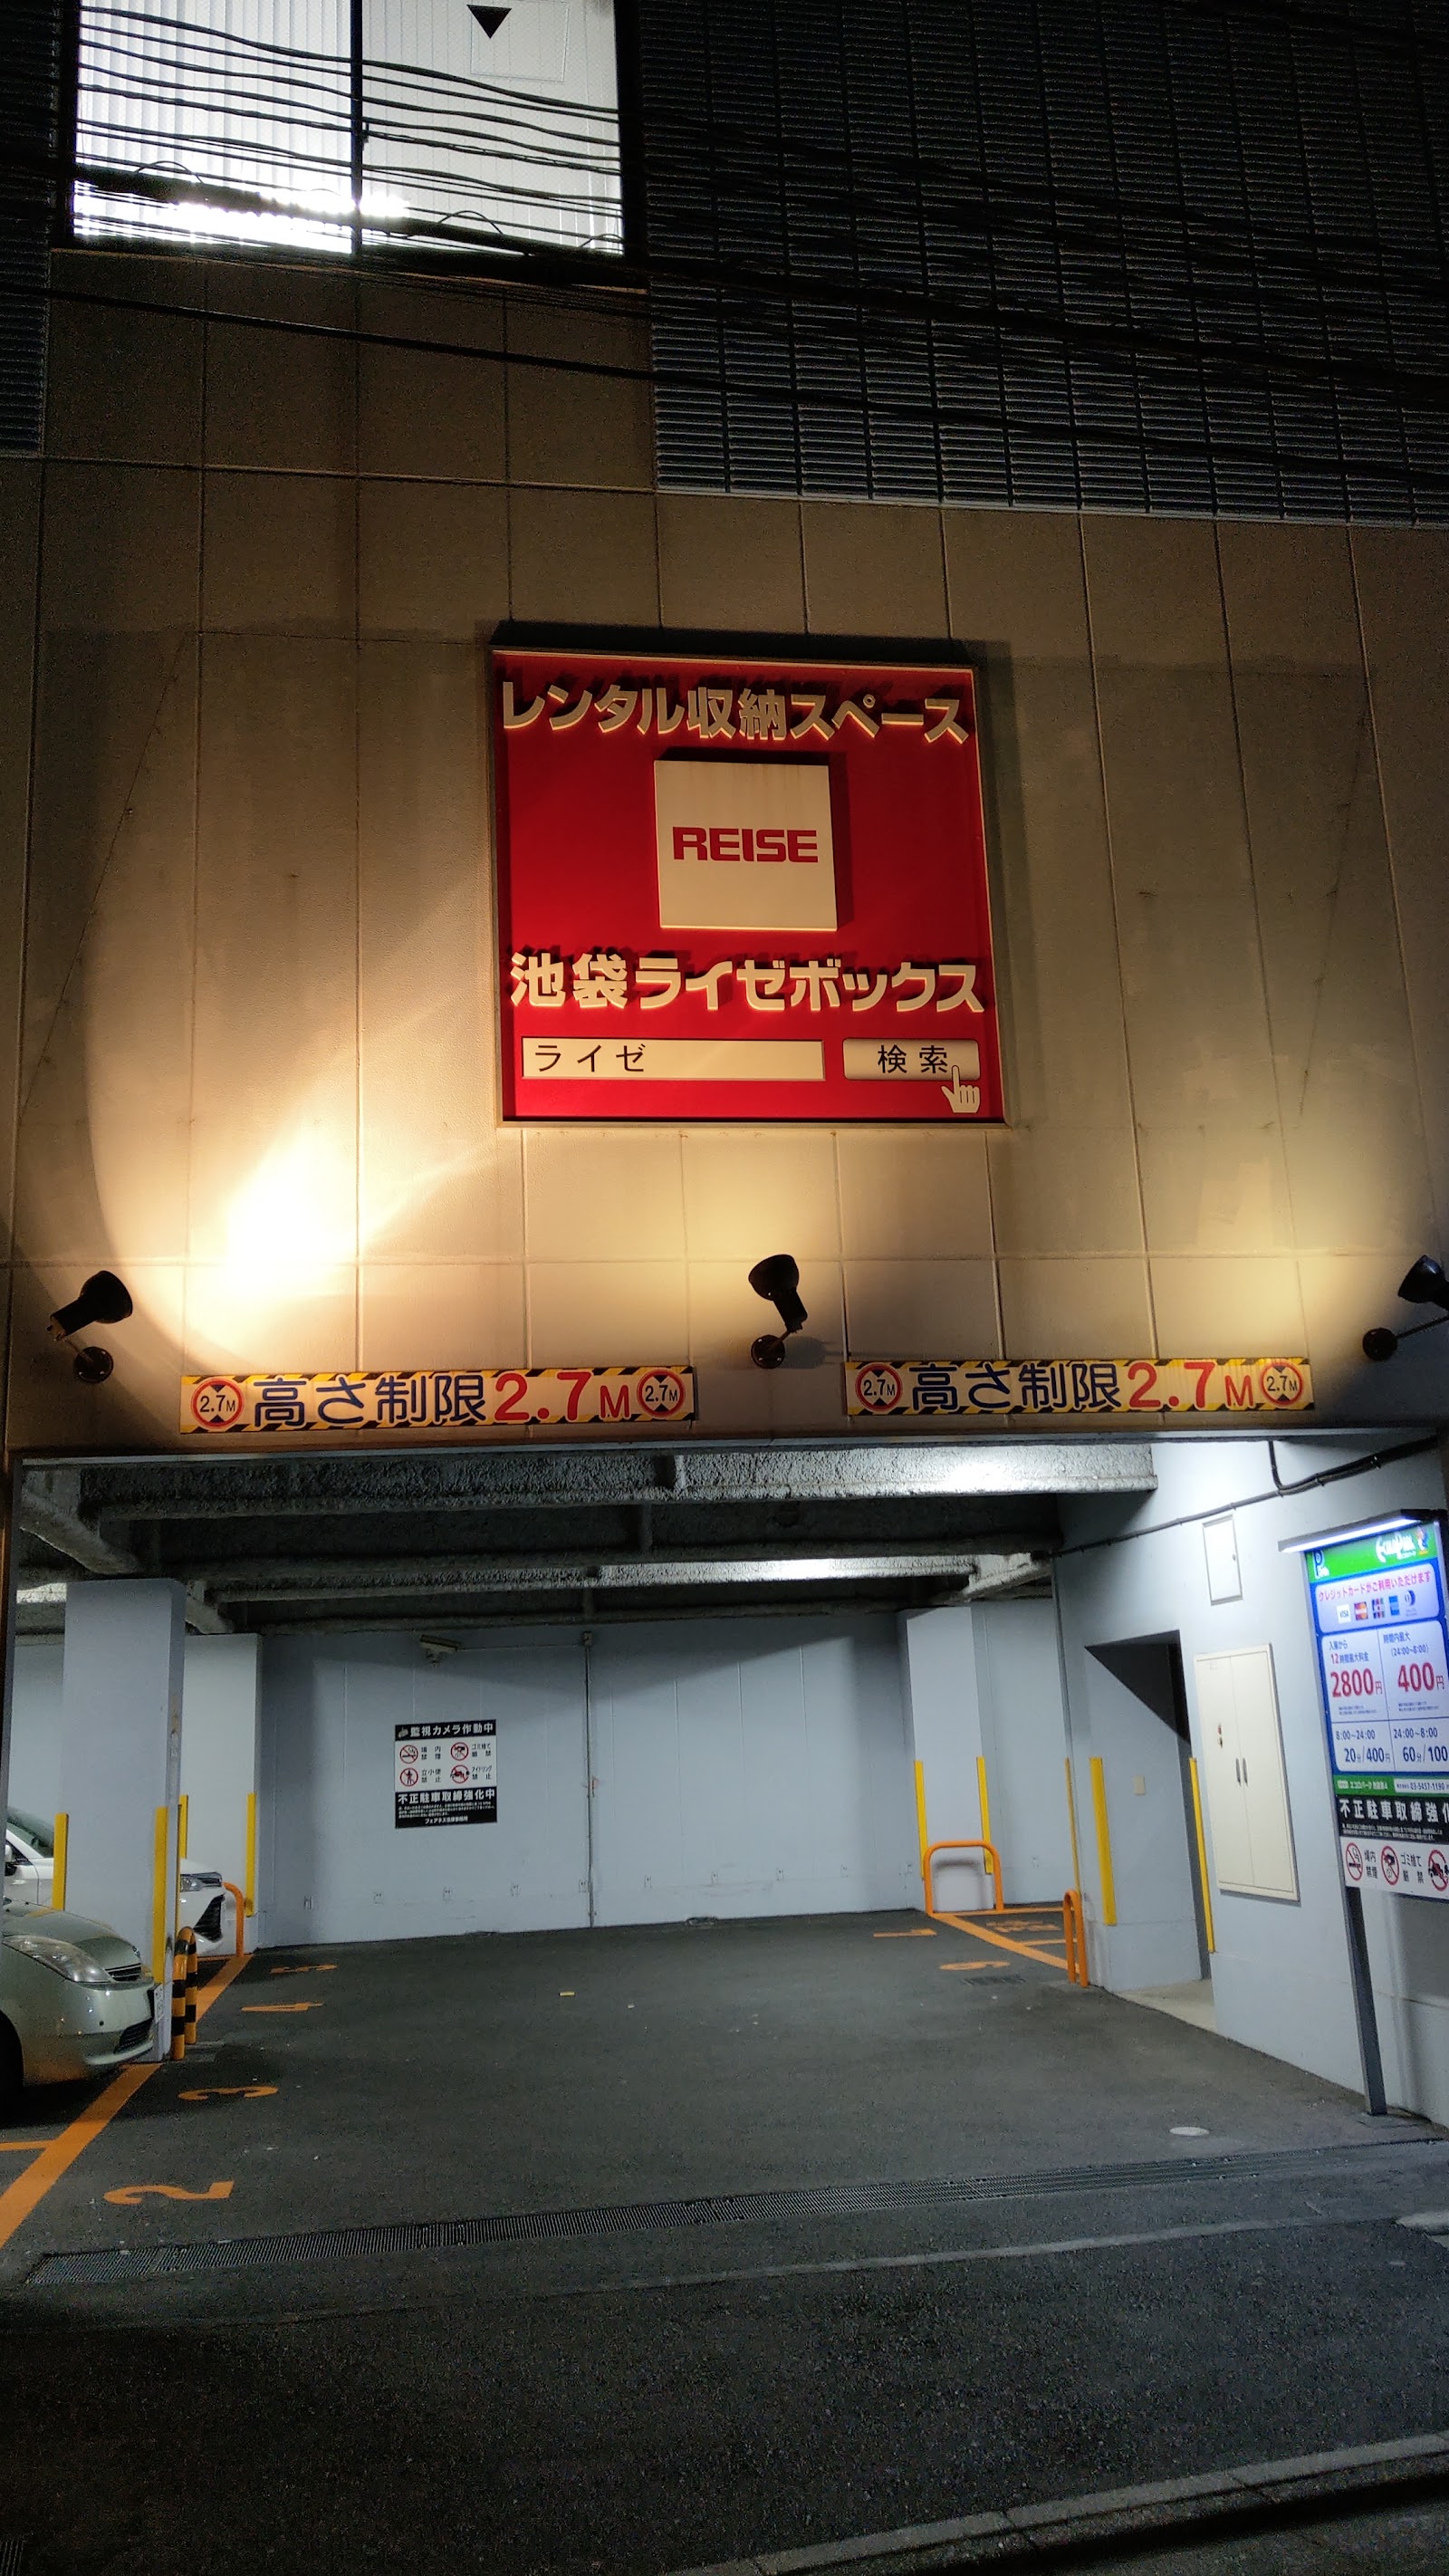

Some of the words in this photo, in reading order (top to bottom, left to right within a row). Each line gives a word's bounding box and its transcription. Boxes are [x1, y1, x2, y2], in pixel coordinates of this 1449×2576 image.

[503, 681, 969, 744] レンタル収納スペース
[673, 826, 818, 863] REISE
[510, 952, 985, 1014] 池袋ライゼボックス
[534, 1043, 645, 1074] ライゼ
[877, 1044, 949, 1075] 検索
[644, 1386, 679, 1404] 2.7M
[863, 1379, 896, 1397] 2.7M
[1275, 1375, 1308, 1392] 2.7M
[199, 1394, 236, 1413] 2.7M
[1319, 1571, 1431, 1602] クレジットカードがご利用いただけます
[1330, 1668, 1383, 1698] 2800円
[1398, 1662, 1444, 1692] 400円
[410, 1723, 494, 1737] 監視カメラ作動中
[398, 1789, 495, 1804] 不正駐車取締強化中
[104, 2180, 235, 2206] 2
